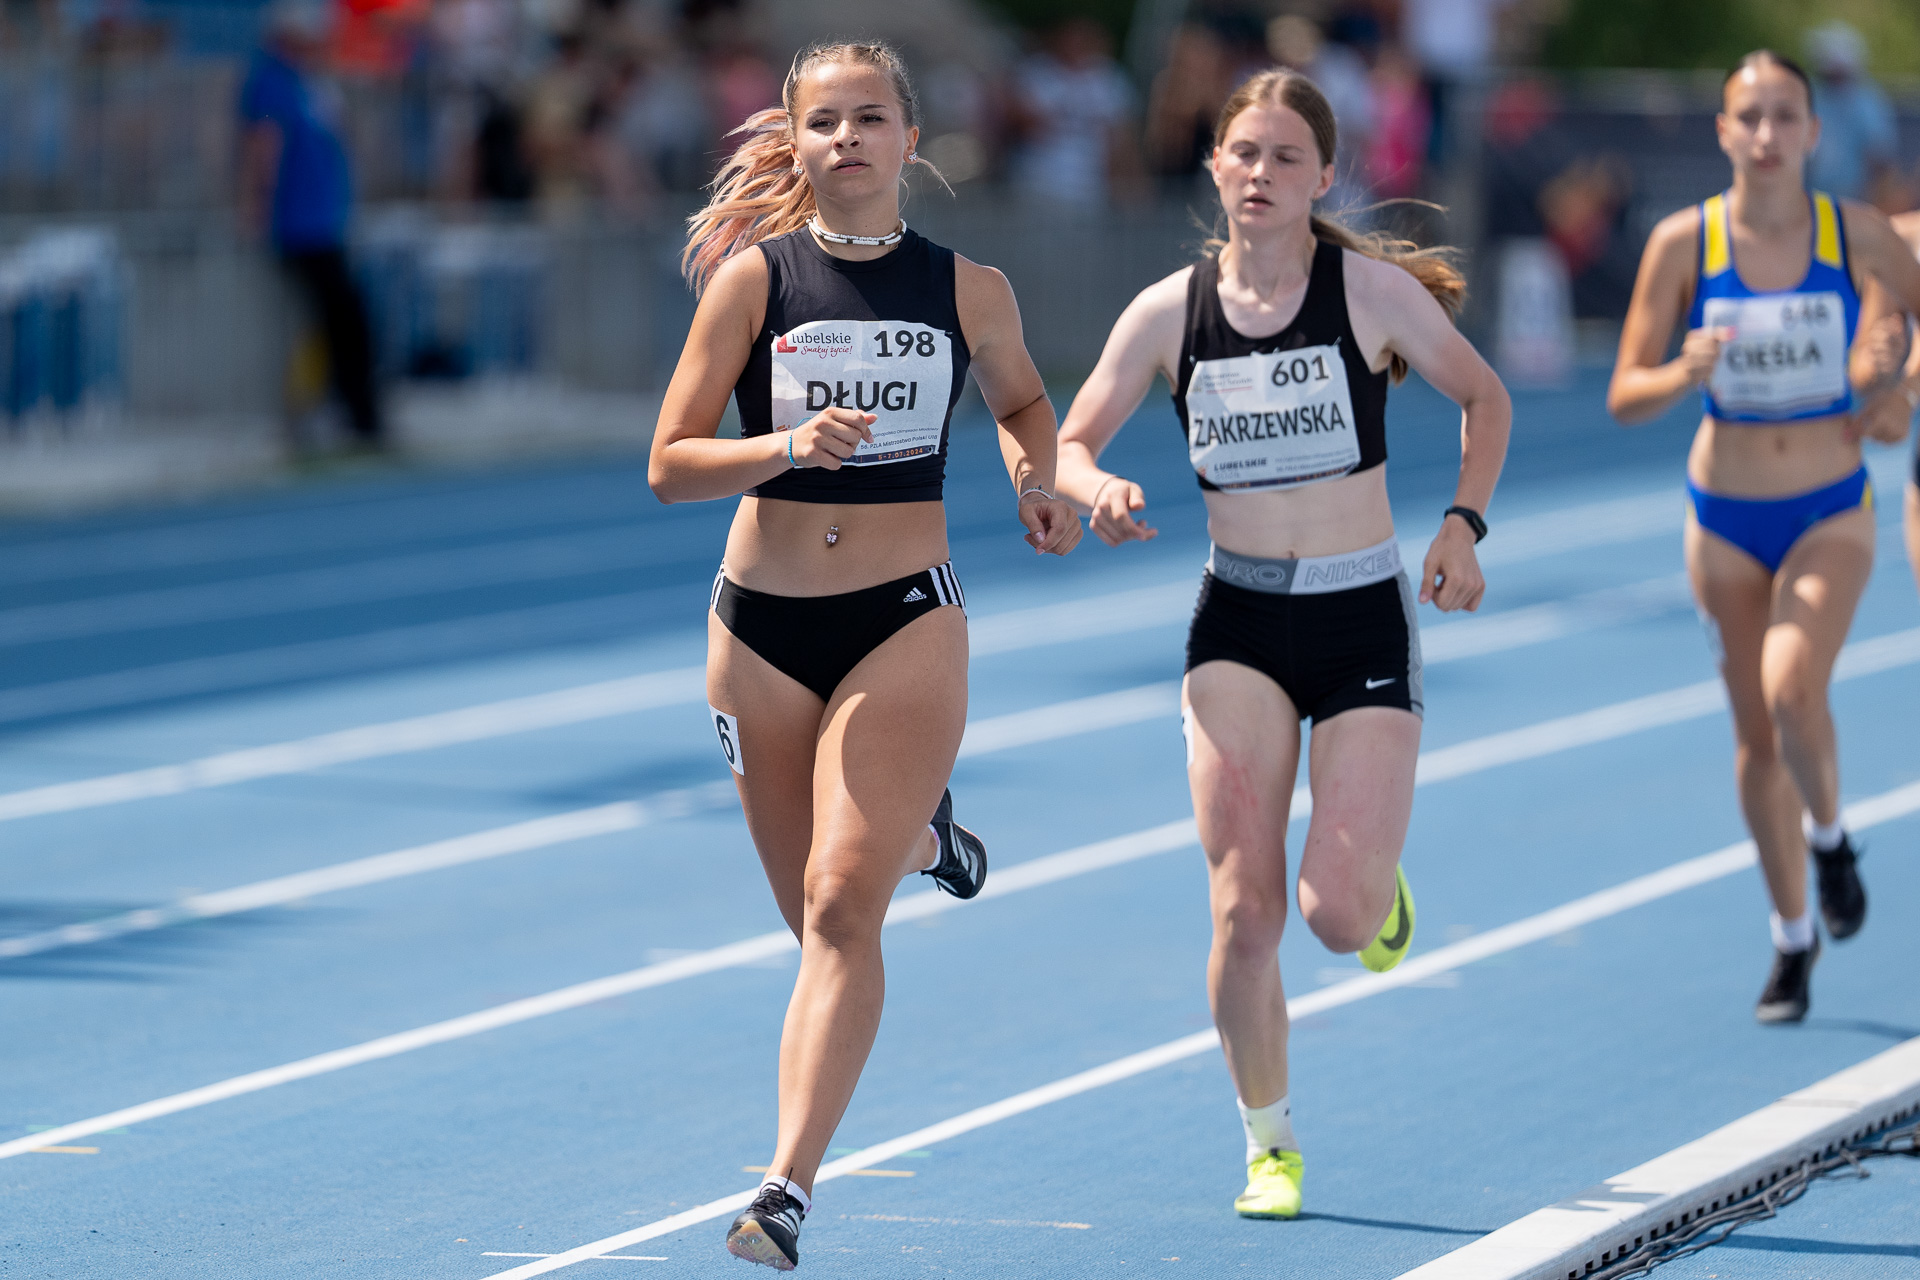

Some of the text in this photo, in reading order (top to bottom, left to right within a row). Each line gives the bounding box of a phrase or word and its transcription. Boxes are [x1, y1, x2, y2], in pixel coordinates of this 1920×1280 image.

[792, 332, 852, 344] lubelskie
[801, 345, 853, 359] Smakuj życie!
[873, 330, 936, 358] 198
[1271, 355, 1330, 387] 601
[806, 380, 918, 412] DŁUGI
[1195, 401, 1346, 448] ZAKRZEWSKA
[883, 437, 911, 447] Mistrzostwa
[1304, 548, 1393, 587] NIKE
[903, 593, 928, 603] adidas
[716, 714, 735, 765] 6
